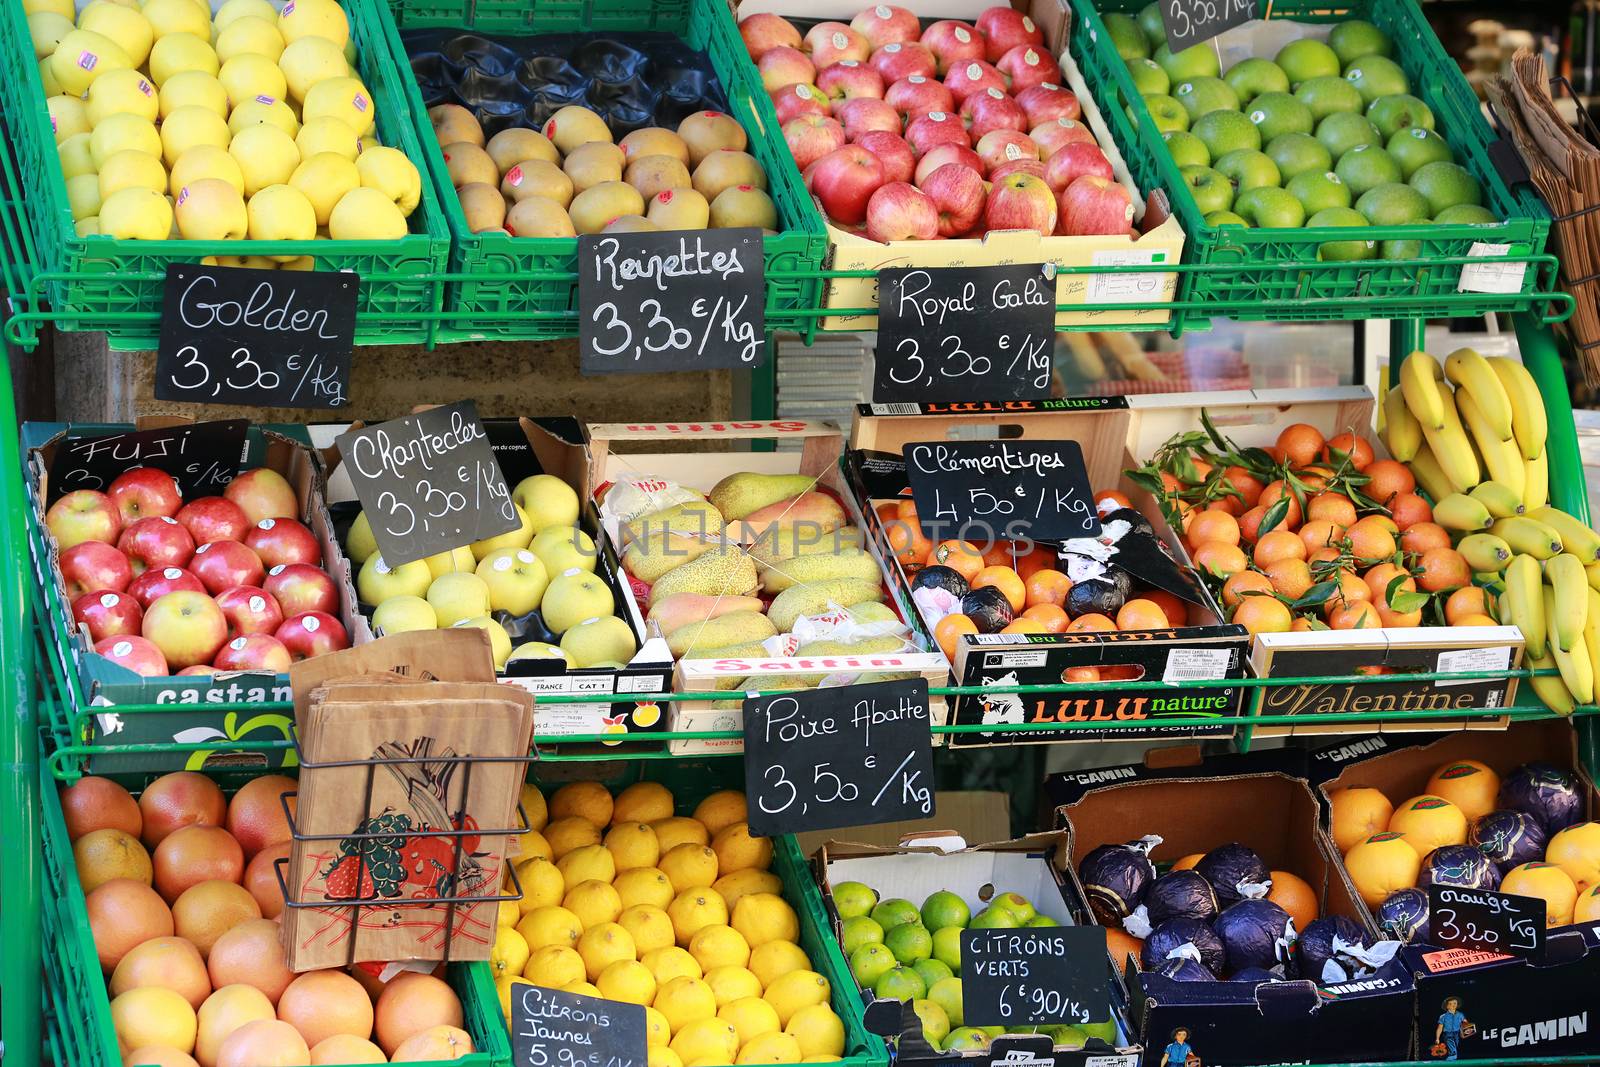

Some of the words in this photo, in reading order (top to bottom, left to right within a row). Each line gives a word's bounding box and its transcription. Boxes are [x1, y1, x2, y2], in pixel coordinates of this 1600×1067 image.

[595, 236, 745, 291] Reinettes
[179, 275, 338, 339] Golden
[898, 270, 976, 327] Royal
[992, 277, 1049, 313] Gala
[1042, 399, 1101, 409] nature
[353, 411, 487, 479] Chantecler
[912, 443, 1065, 477] Clémentines
[1031, 696, 1149, 724] LULU
[1150, 694, 1228, 712] nature
[1267, 684, 1475, 716] Valentine
[765, 697, 839, 743] Poire
[1000, 729, 1055, 737] SAVEUR
[1160, 724, 1224, 732] COULEUR
[1315, 752, 1328, 761] LE
[1327, 736, 1389, 762] GAMIN
[1062, 774, 1076, 782] LE
[1076, 766, 1137, 785] GAMIN
[1436, 908, 1499, 943] 3,20
[1508, 917, 1537, 950] Kg
[975, 959, 1030, 978] VERTS
[1324, 978, 1389, 995] GAMIN
[1482, 1028, 1498, 1041] LE
[1500, 1010, 1588, 1049] GAMIN
